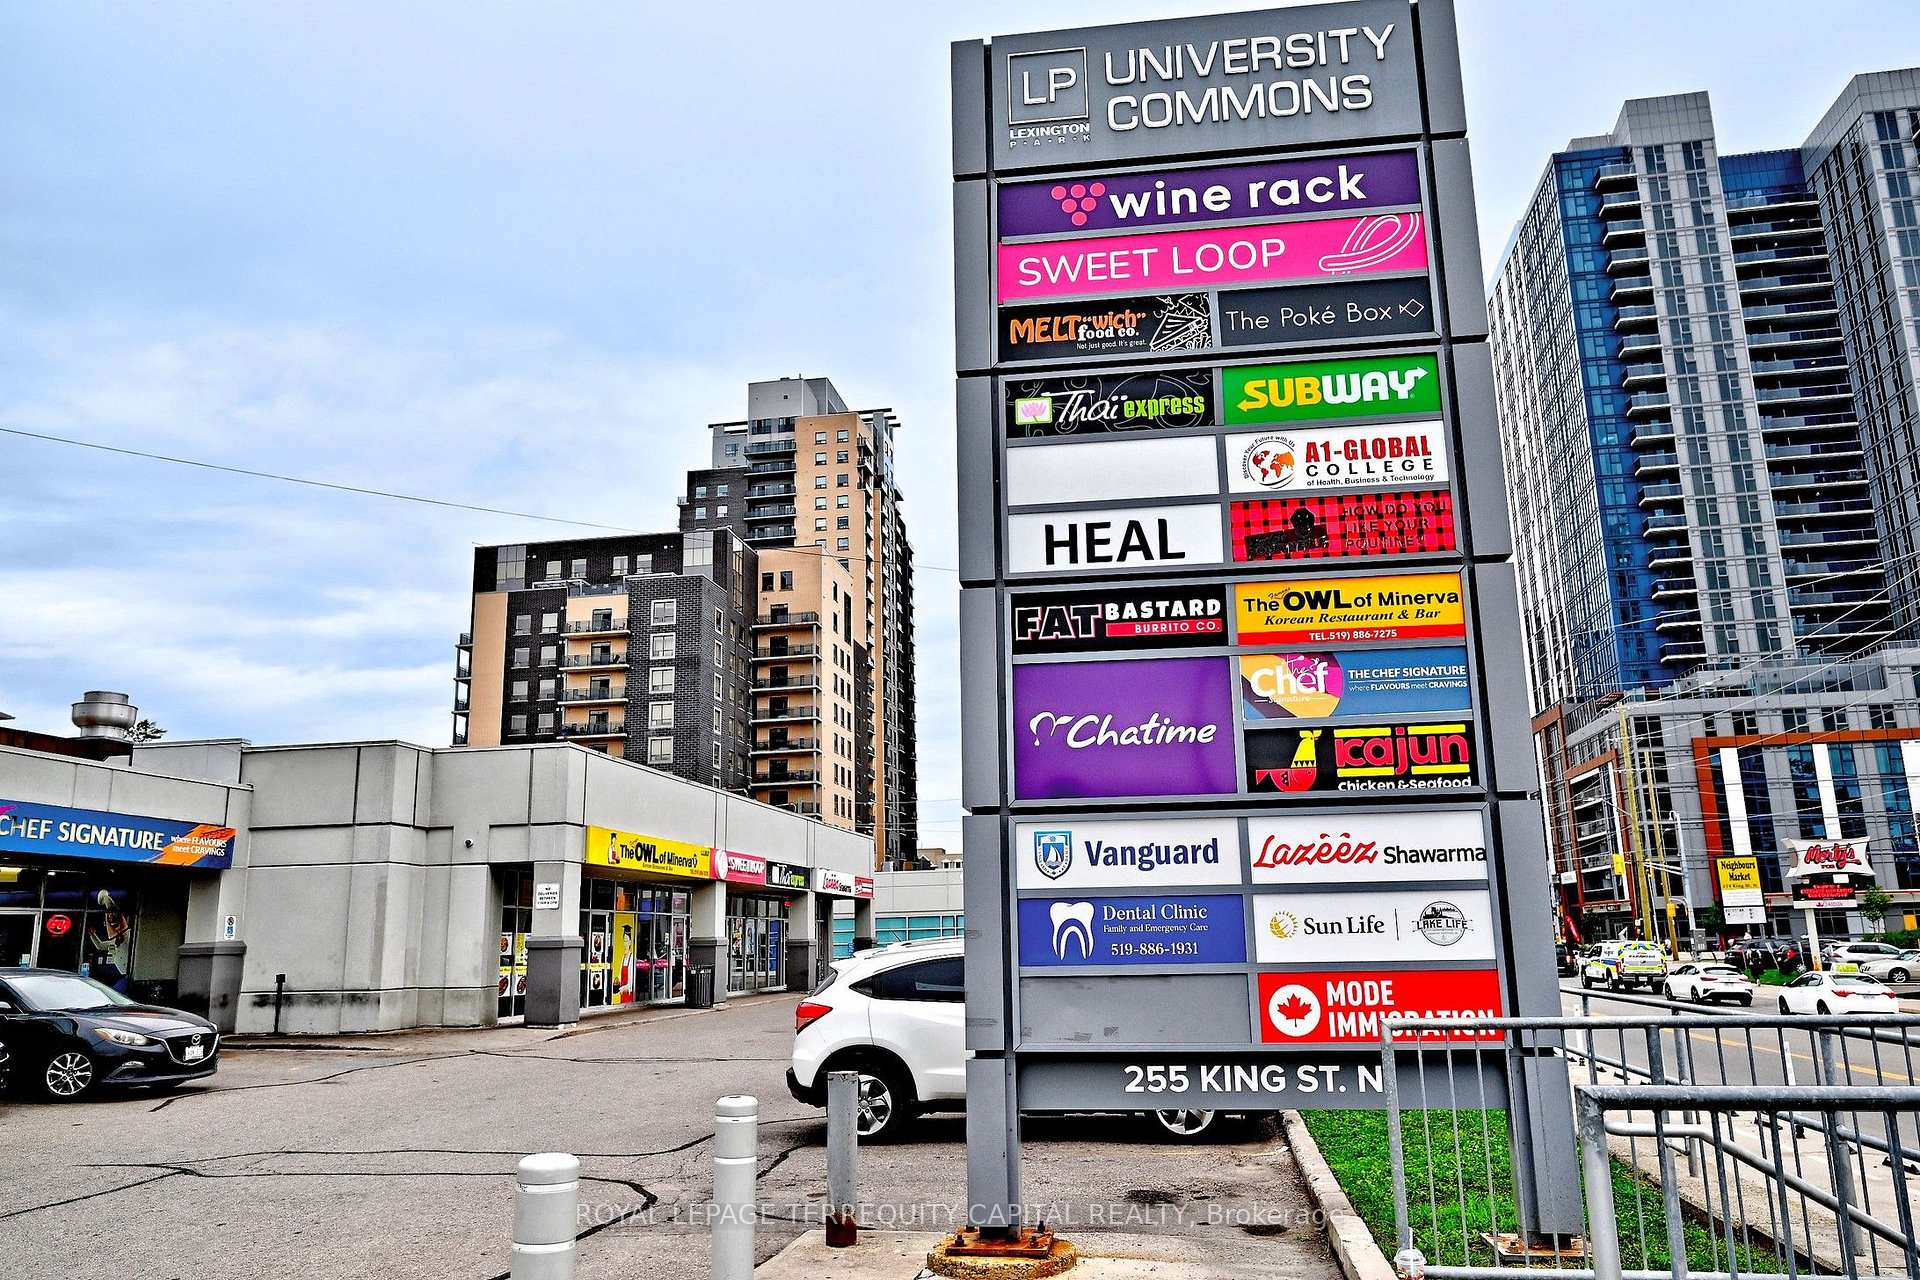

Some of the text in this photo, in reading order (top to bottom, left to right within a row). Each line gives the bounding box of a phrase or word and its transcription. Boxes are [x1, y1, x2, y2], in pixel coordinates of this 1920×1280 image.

[1105, 23, 1395, 86] UNIVERSITY
[1023, 67, 1077, 105] LP
[1107, 74, 1373, 131] COMMONS
[1010, 122, 1090, 139] LEXINGTON
[1109, 165, 1366, 220] wine rack
[1018, 238, 1286, 287] SWEET LOOP
[1225, 302, 1392, 331] The Poké Box
[1078, 324, 1139, 341] food co.
[1088, 341, 1100, 350] just
[1129, 339, 1147, 348] great.
[1237, 366, 1429, 412] SUBWAY
[1124, 395, 1205, 419] express
[1241, 454, 1250, 480] Discover
[1254, 435, 1275, 445] Future
[1275, 435, 1288, 443] with
[1288, 440, 1296, 448] Us
[1305, 435, 1432, 463] A1-GLOBAL
[1306, 458, 1434, 477] COLLEGE
[1316, 478, 1343, 487] Health,
[1344, 476, 1380, 485] Business
[1382, 475, 1388, 483] &
[1390, 473, 1435, 484] Technology
[1343, 501, 1447, 517] HOW DO YOU
[1346, 518, 1430, 534] LIKE YOUR
[1044, 518, 1186, 566] HEAL
[1243, 589, 1459, 613] The OWL of Minerva
[1015, 599, 1221, 640] FAT BASTARD
[1135, 621, 1221, 634] BURRITO CO.
[1264, 609, 1441, 626] Korean Restaurant & Bar
[1353, 629, 1397, 639] 886-7275
[1251, 661, 1329, 698] Chef
[1349, 665, 1467, 679] THE CHEF SIGNATURE
[1349, 680, 1468, 692] where FLAVOURS meet CRAVINGS
[1066, 712, 1217, 749] Chatime
[0, 814, 166, 851] CHEF SIGNATURE
[171, 835, 228, 849] where FLAVOURS
[173, 845, 226, 857] meet CRAVINGS
[620, 843, 634, 860] The
[635, 841, 660, 864] OWL
[659, 851, 667, 864] of
[667, 851, 693, 869] Minerva
[1084, 837, 1219, 872] Vanguard
[1384, 846, 1488, 865] Shawarma
[1720, 861, 1756, 871] Neighbours
[1728, 872, 1752, 881] Market
[1103, 904, 1208, 921] Dental Clinic
[1103, 923, 1209, 934] Family and Emergency Care
[1303, 914, 1386, 936] Sun Life
[1416, 919, 1469, 930] LAKE LIFE
[1111, 942, 1199, 956] 519-886-1931
[1326, 980, 1395, 1007] MODE
[1123, 1065, 1384, 1093] 255 KING ST. N
